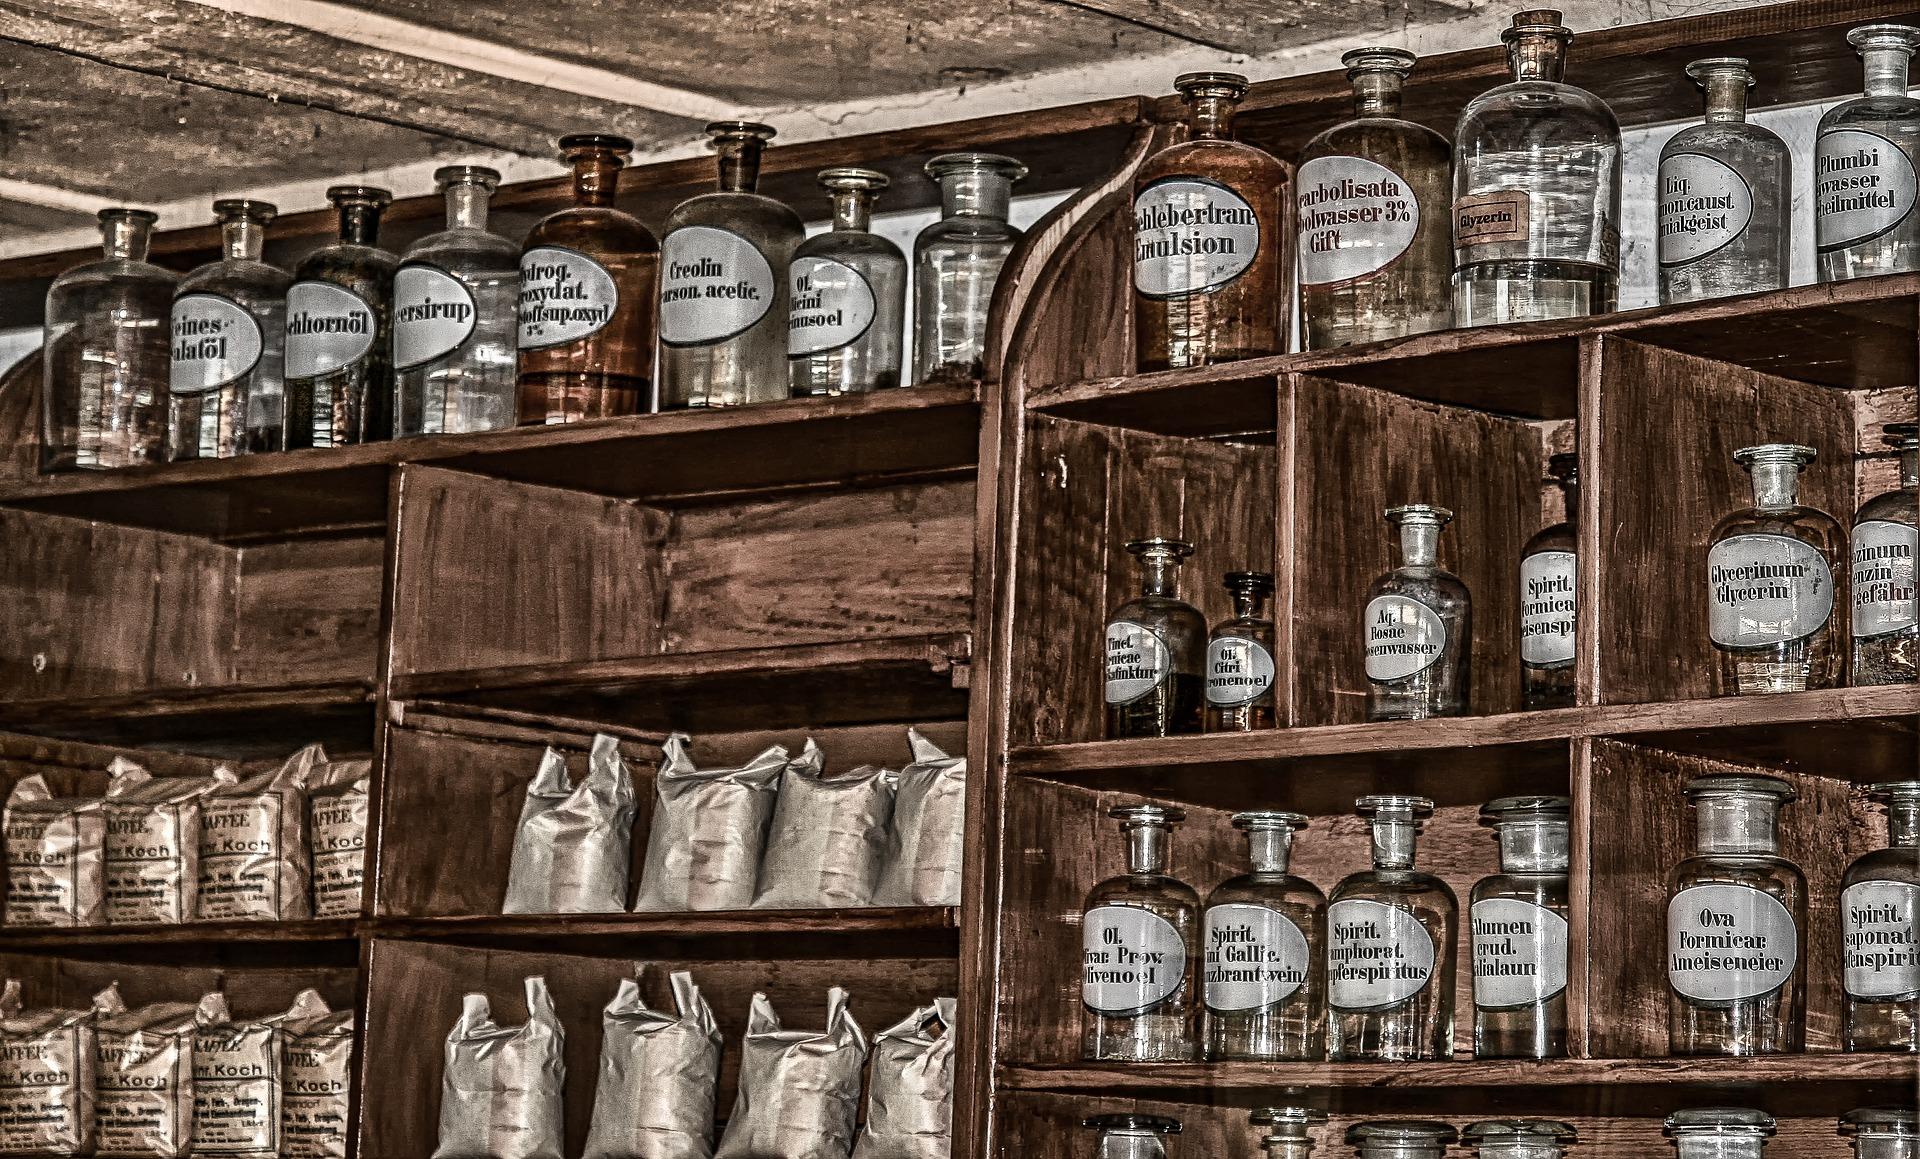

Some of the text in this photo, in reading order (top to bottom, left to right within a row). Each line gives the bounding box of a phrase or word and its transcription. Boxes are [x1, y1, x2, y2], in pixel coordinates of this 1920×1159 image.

[1820, 148, 1879, 173] Plumbi
[1666, 175, 1690, 196] Liq.
[1385, 200, 1410, 223] 3%
[1460, 210, 1512, 229] Glyzerin
[1136, 230, 1236, 263] Emulsion
[1310, 229, 1341, 253] Gift
[670, 257, 722, 280] Creolin
[706, 281, 760, 301] acetic.
[1854, 542, 1910, 565] zinum
[1711, 561, 1804, 586] Glycerinum
[1528, 574, 1573, 599] Spirit.
[1717, 582, 1788, 607] Glycerin
[1377, 608, 1396, 627] Aq.
[1371, 625, 1405, 641] Rosae
[1214, 660, 1240, 674] Citri
[124, 844, 169, 857] Koch
[223, 839, 271, 852] Koch
[327, 836, 364, 849] Koc
[1699, 908, 1735, 928] Ova
[1851, 903, 1902, 926] Spirit.
[1103, 927, 1123, 945] Ol.
[1211, 925, 1255, 947] Spirit.
[1334, 920, 1381, 943] Spirit.
[1845, 925, 1918, 948] saponat.
[1117, 946, 1164, 965] Prov.
[1477, 937, 1517, 957] crud.
[1671, 951, 1784, 972] Ameiseneier
[1085, 966, 1155, 984] livenoel
[214, 1064, 263, 1077] Koch
[118, 1074, 168, 1088] Koch
[296, 1079, 342, 1092] Koch
